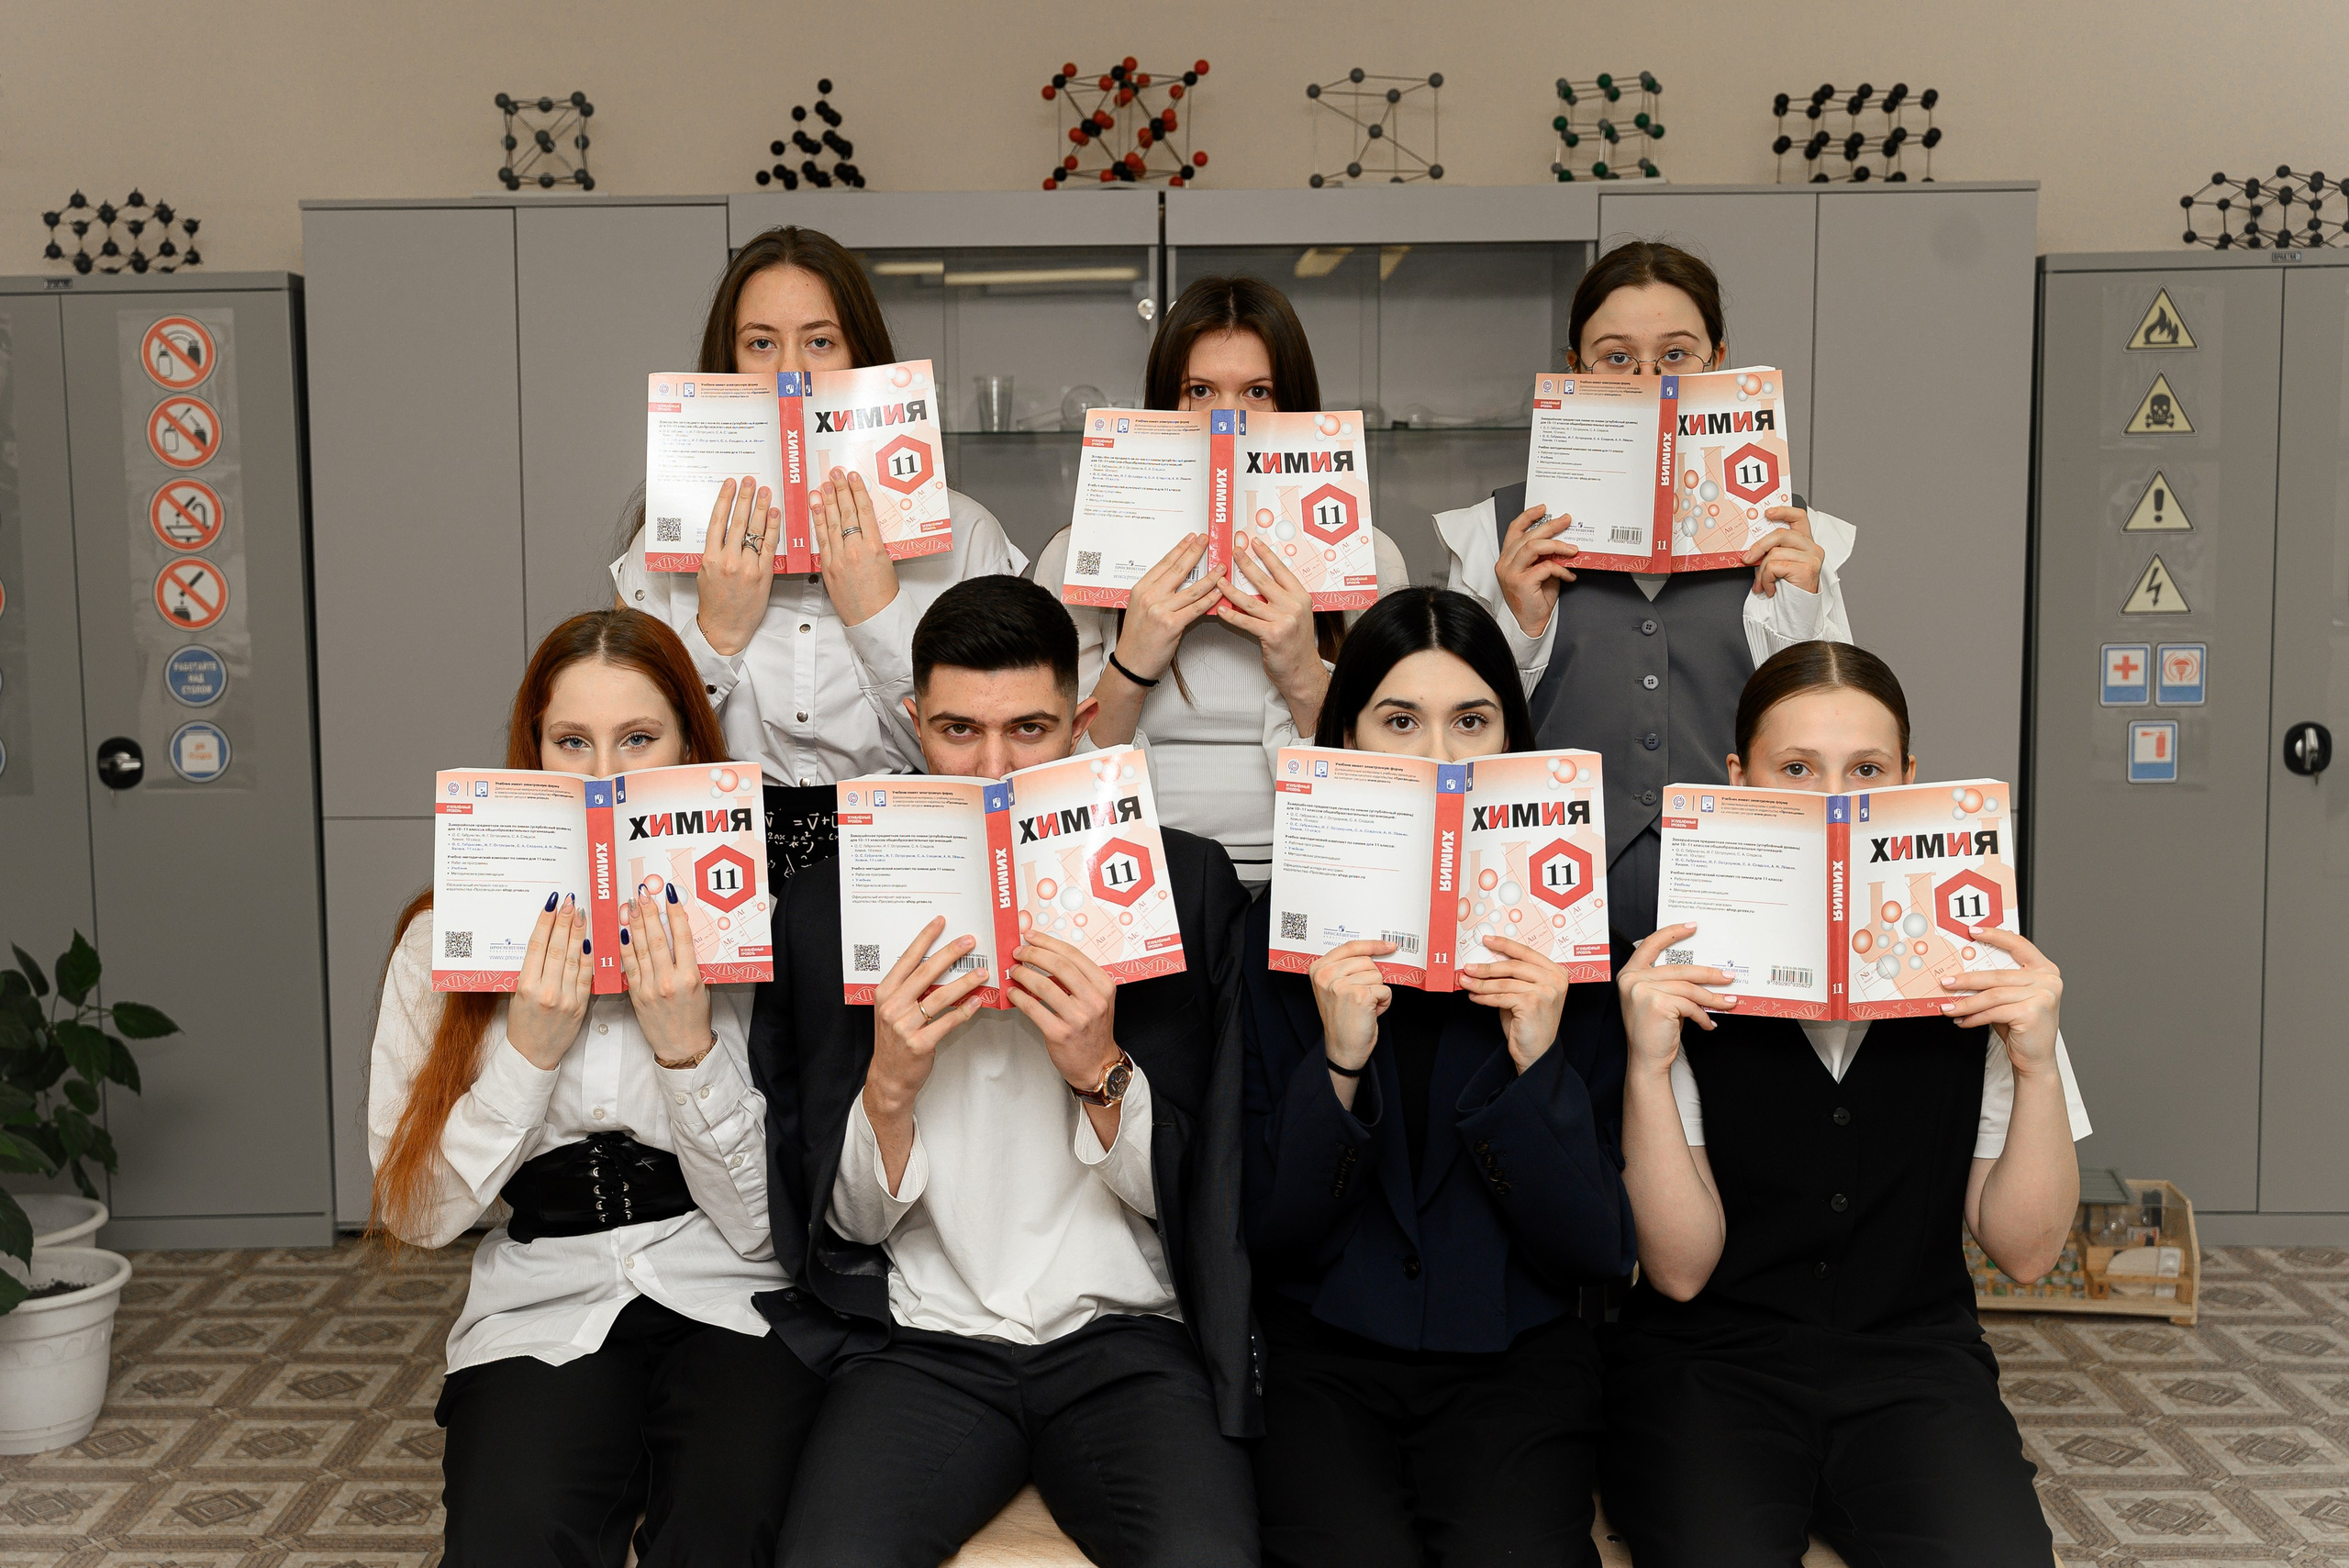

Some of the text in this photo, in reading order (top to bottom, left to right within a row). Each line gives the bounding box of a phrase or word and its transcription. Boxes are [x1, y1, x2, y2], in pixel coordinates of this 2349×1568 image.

[815, 399, 928, 433] ХИМИЯ
[1677, 409, 1775, 437] ХИМИЯ
[786, 429, 801, 484] ХИМИЯ
[893, 454, 918, 476] 11
[1246, 450, 1354, 474] ХИМИЯ
[1661, 431, 1672, 486] ХИМИЯ
[1740, 463, 1765, 484] 11
[1215, 467, 1228, 523] ХИМИЯ
[1318, 505, 1343, 526] 11
[792, 538, 806, 549] 11
[1656, 540, 1667, 550] 11
[629, 807, 752, 840] ХИМИЯ
[1018, 795, 1143, 845] ХИМИЯ
[1471, 800, 1590, 832] ХИМИЯ
[1869, 830, 1999, 863] ХИМИЯ
[595, 841, 610, 900] ХИМИЯ
[1106, 860, 1137, 886] 11
[1438, 829, 1455, 892] ХИМИЯ
[711, 867, 740, 891] 11
[995, 847, 1011, 909] ХИМИЯ
[1546, 862, 1575, 887] 11
[1831, 860, 1843, 922] ХИМИЯ
[1953, 894, 1986, 918] 11
[600, 956, 615, 968] 11
[1433, 951, 1449, 963] 11
[1004, 969, 1012, 981] 1
[1831, 983, 1843, 995] 11
